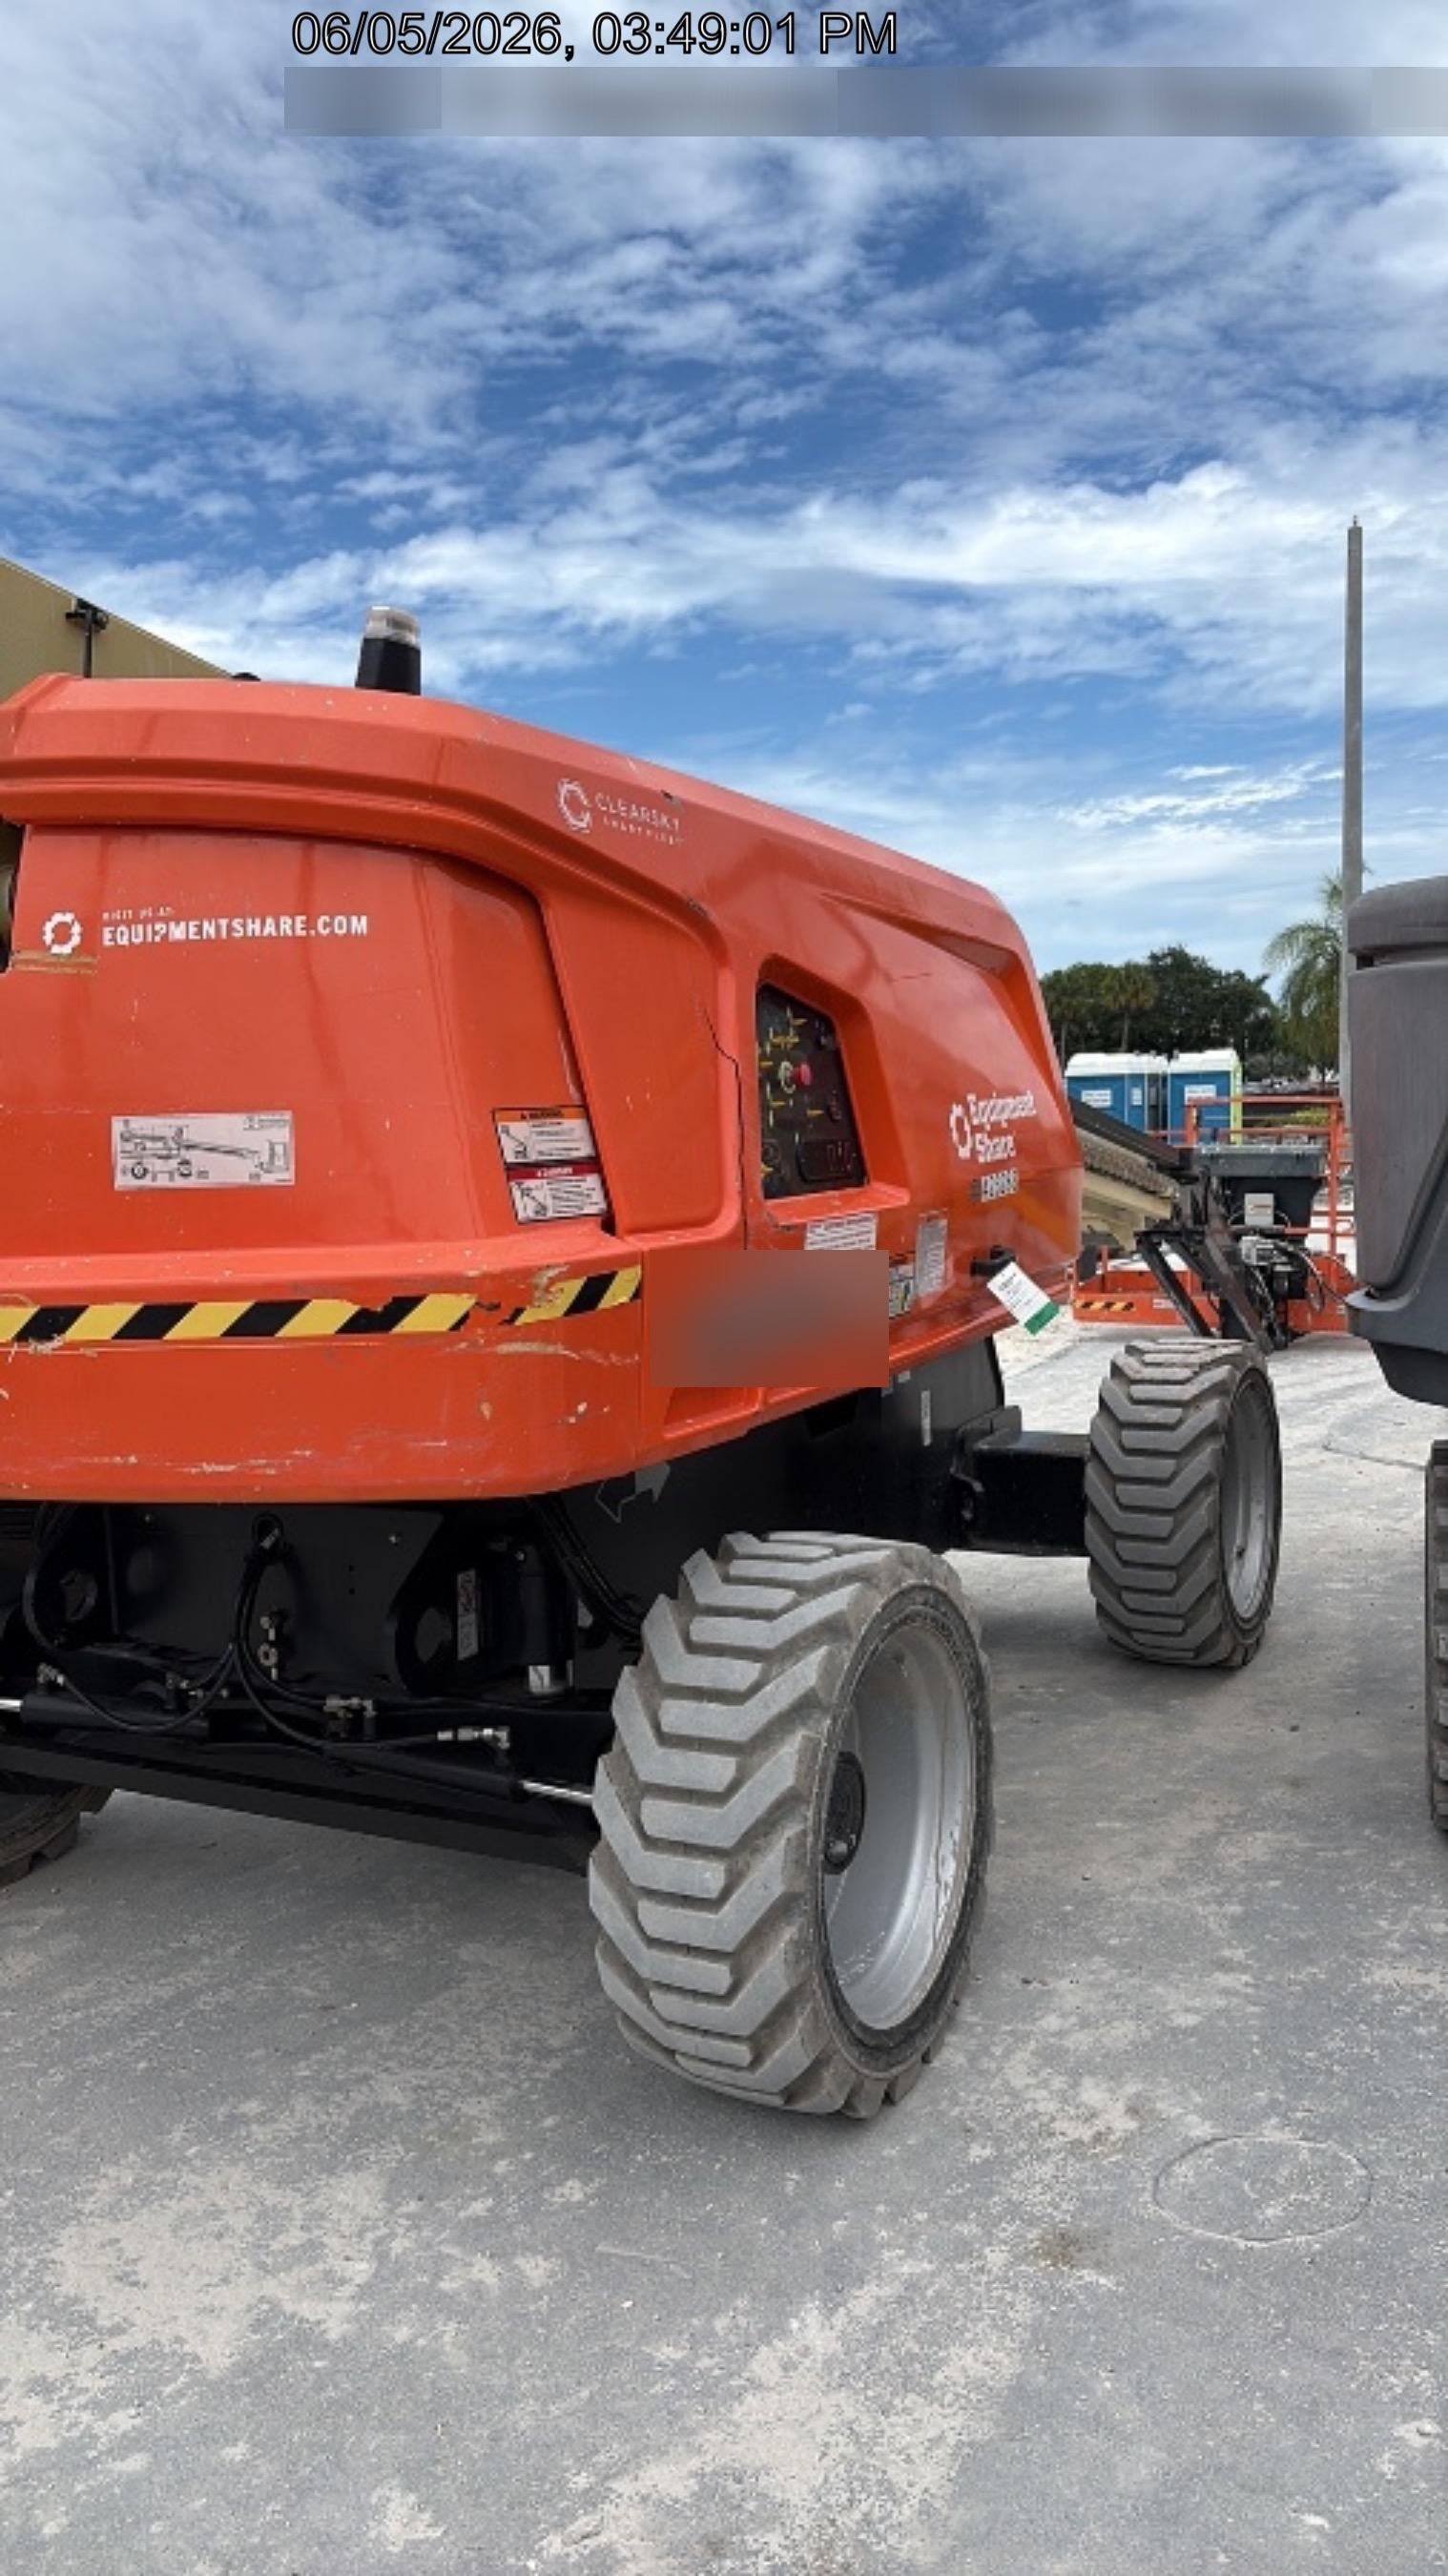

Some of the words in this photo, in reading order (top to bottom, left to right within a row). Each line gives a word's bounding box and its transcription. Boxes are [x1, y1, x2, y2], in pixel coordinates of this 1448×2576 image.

[594, 792, 680, 833] CLEARSKY
[101, 915, 369, 946] EQUIPMENTSHARE.COM
[965, 1090, 1037, 1132] Equipment
[975, 1132, 1017, 1164] Share
